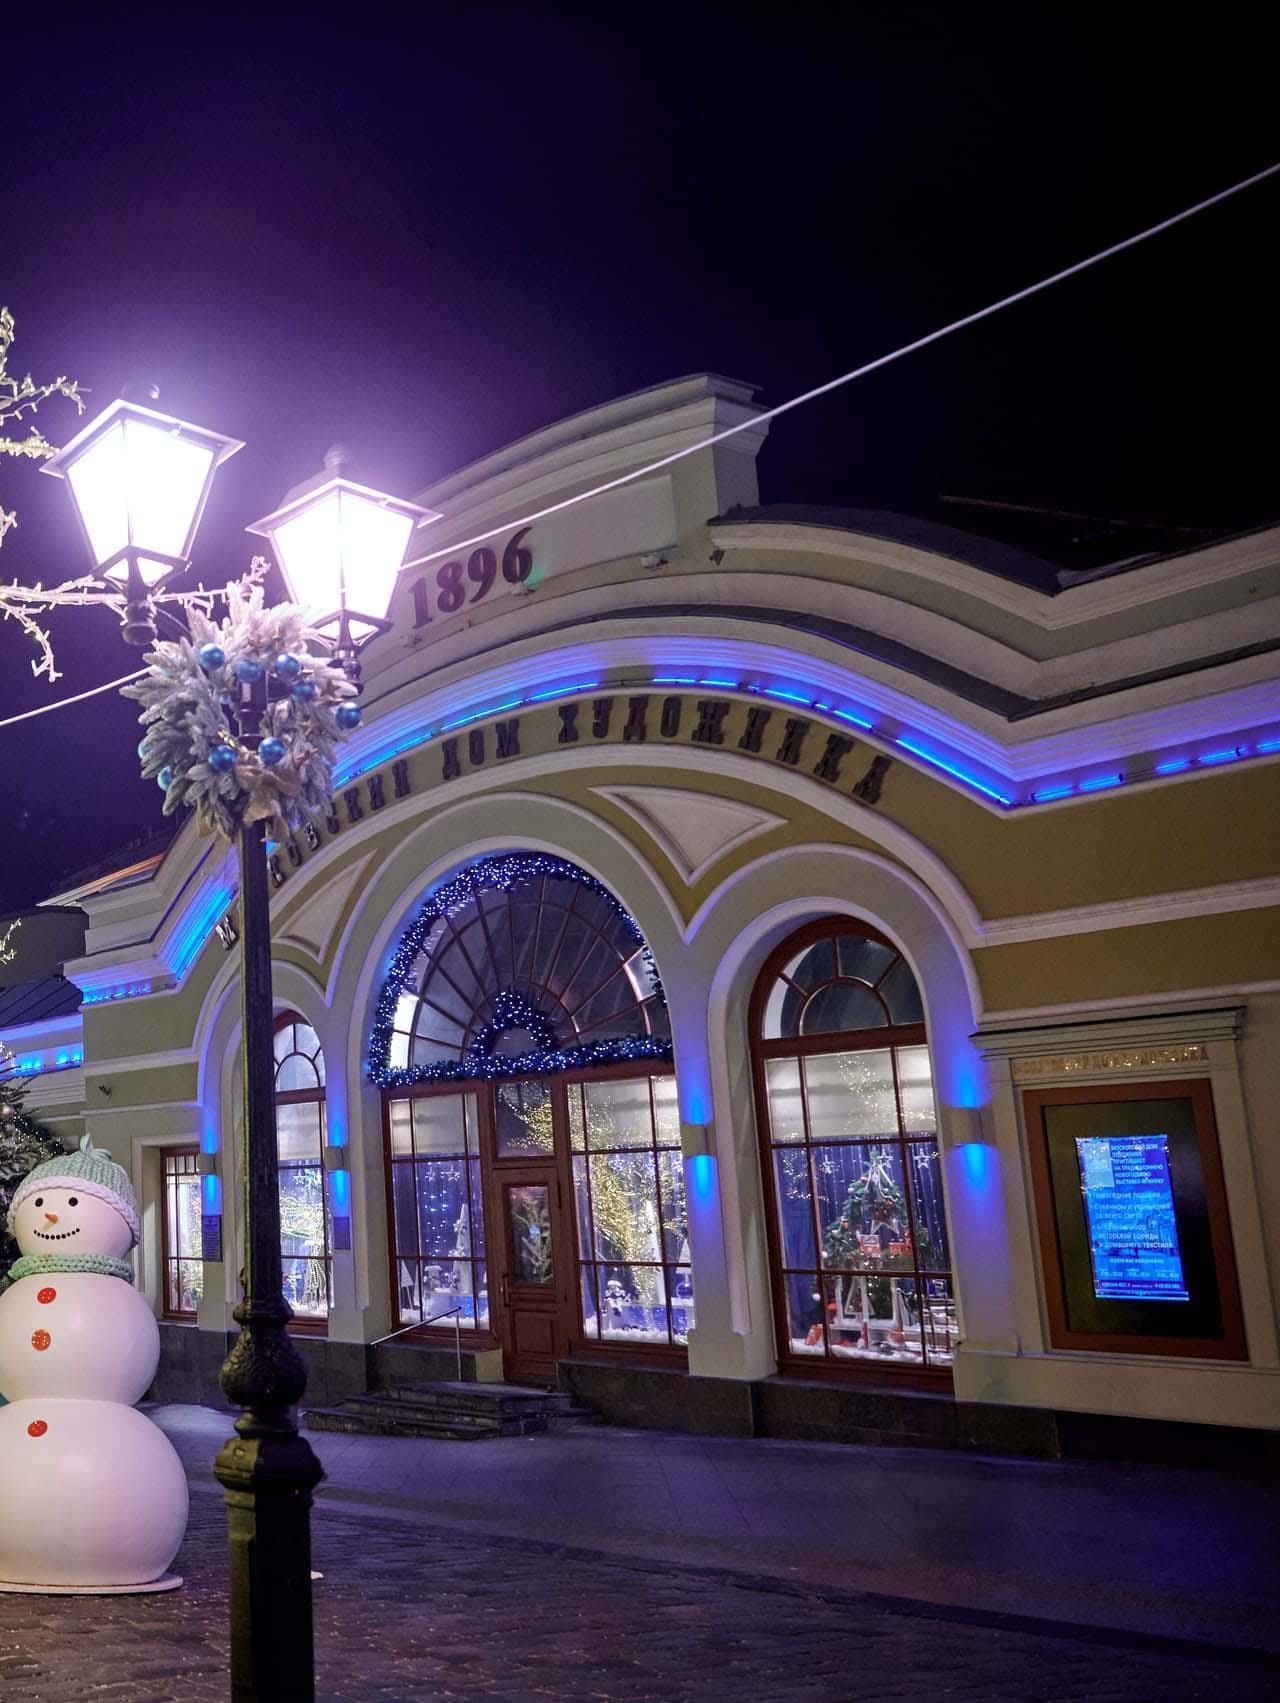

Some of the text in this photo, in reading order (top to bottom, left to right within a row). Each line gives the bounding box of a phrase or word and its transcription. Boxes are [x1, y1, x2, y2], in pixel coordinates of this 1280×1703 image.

[409, 527, 533, 629] 1896
[442, 718, 521, 780] ДОМ
[558, 695, 892, 805] ХУДОЖНИКА
